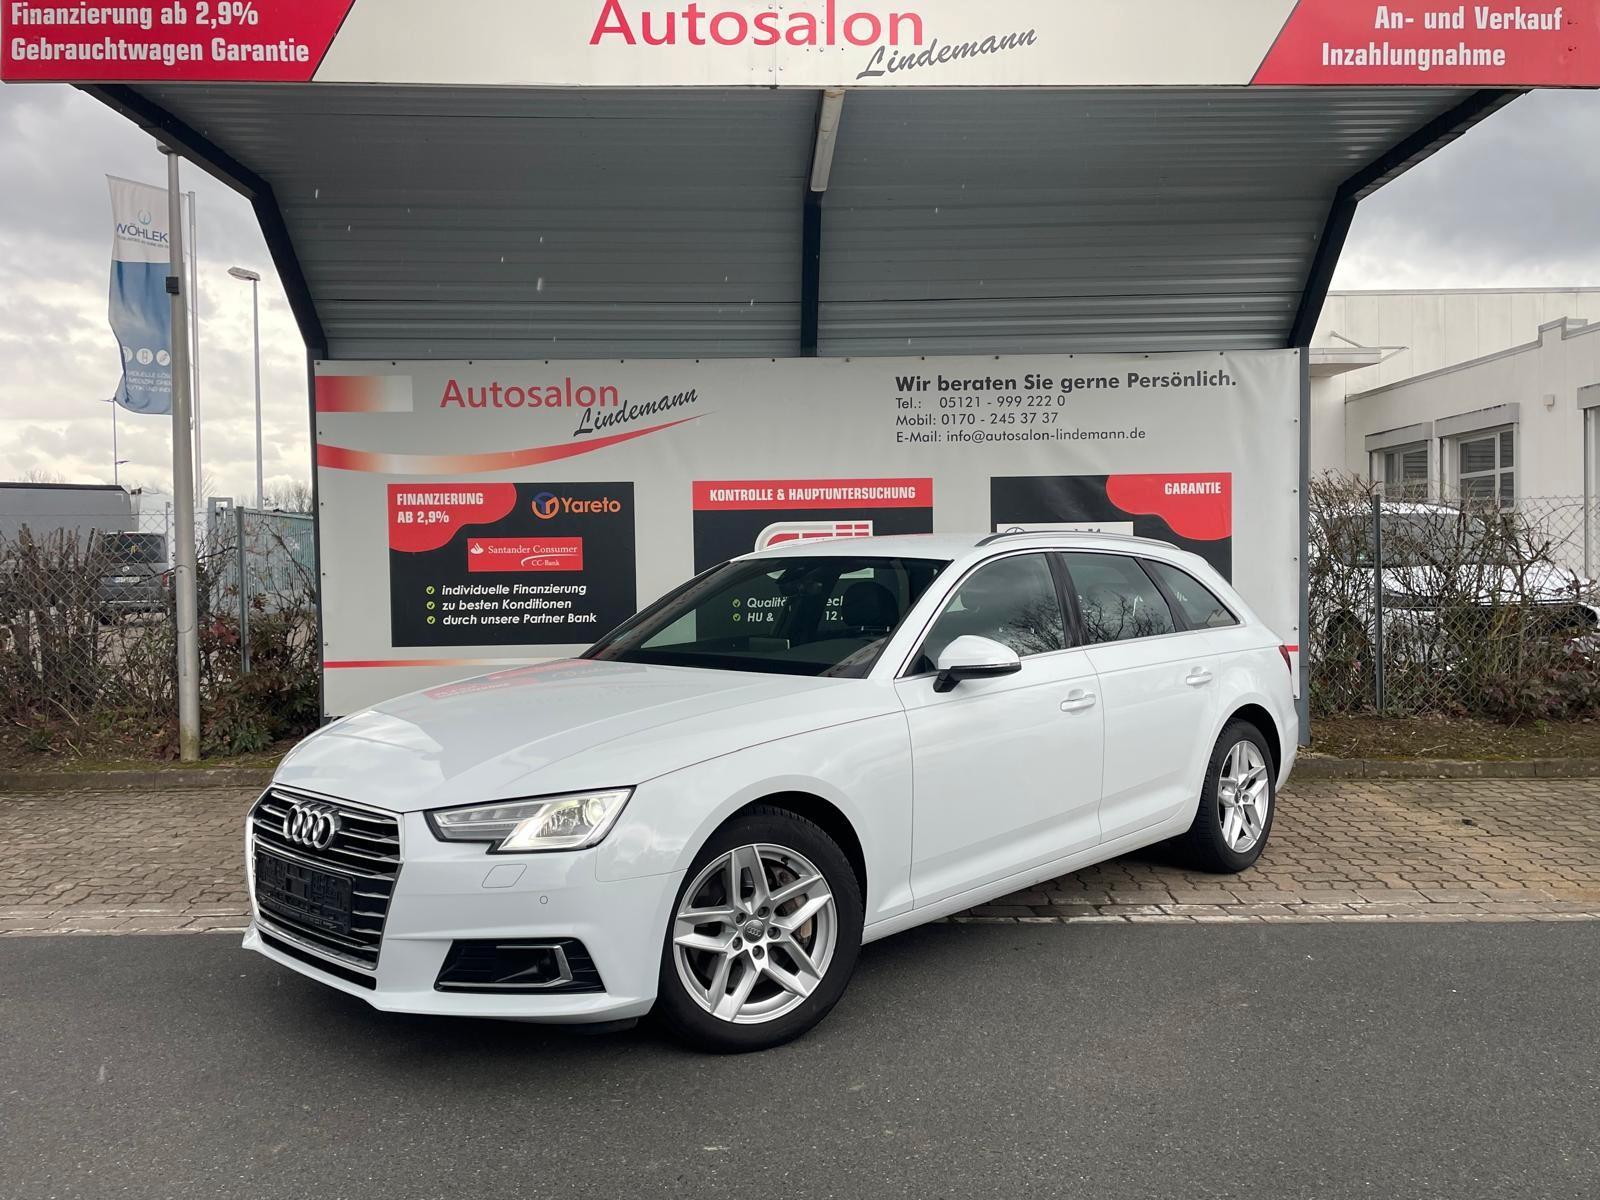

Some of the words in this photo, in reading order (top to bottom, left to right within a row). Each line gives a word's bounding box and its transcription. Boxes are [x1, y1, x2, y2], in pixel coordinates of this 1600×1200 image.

[11, 2, 152, 30] Finanzierung
[161, 2, 187, 25] ab
[195, 1, 259, 29] 2,9%
[589, 0, 923, 46] Autosalon
[1374, 5, 1414, 29] An-
[1424, 6, 1464, 30] und
[1474, 6, 1563, 31] Verkauf
[11, 37, 203, 66] Gebrauchtwagen
[211, 37, 310, 62] Garantie
[856, 28, 1038, 80] Lindemann
[1321, 42, 1506, 71] Inzahlungnahme
[116, 222, 169, 243] WÖHLEK
[895, 375, 931, 392] Wir
[937, 374, 1018, 392] beraten
[1023, 373, 1054, 391] Sie
[1060, 376, 1120, 394] gerne
[1127, 370, 1237, 389] Persönlich.
[439, 377, 619, 408] Autosalon
[895, 397, 922, 409] Tel.:
[939, 396, 982, 409] 05121
[996, 395, 1022, 408] 999
[1027, 395, 1053, 408] 222
[1057, 395, 1066, 408] 0
[573, 388, 698, 437] Lindemann
[895, 413, 936, 427] Mobil:
[941, 413, 976, 426] 0170
[990, 412, 1015, 425] 245
[1020, 412, 1037, 425] 37
[1042, 412, 1059, 425] 37
[896, 430, 942, 443] E-Mail:
[946, 427, 1146, 444] info@autosalon-lindemann.de
[709, 488, 774, 502] KONTROLLE
[776, 488, 785, 501] &
[788, 486, 916, 501] HAUPTUNTERSUCHUNG
[1164, 481, 1222, 495] GARANTIE
[396, 492, 484, 506] FINANZIERUNG
[561, 497, 621, 514] Yareto
[397, 511, 414, 524] AB
[417, 510, 450, 526] 2,9%
[487, 545, 531, 554] Santander
[532, 544, 578, 554] Consumer
[531, 559, 560, 567] CC-Bank
[441, 584, 510, 596] individuelle
[513, 583, 587, 598] Finanzierung
[442, 601, 456, 611] zu
[458, 599, 500, 611] besten
[502, 598, 572, 610] Konditionen
[442, 614, 478, 626] durch
[481, 614, 520, 625] unsere
[523, 613, 565, 625] Partner
[567, 612, 598, 624] Bank
[747, 612, 763, 622] HU
[766, 612, 774, 622] &
